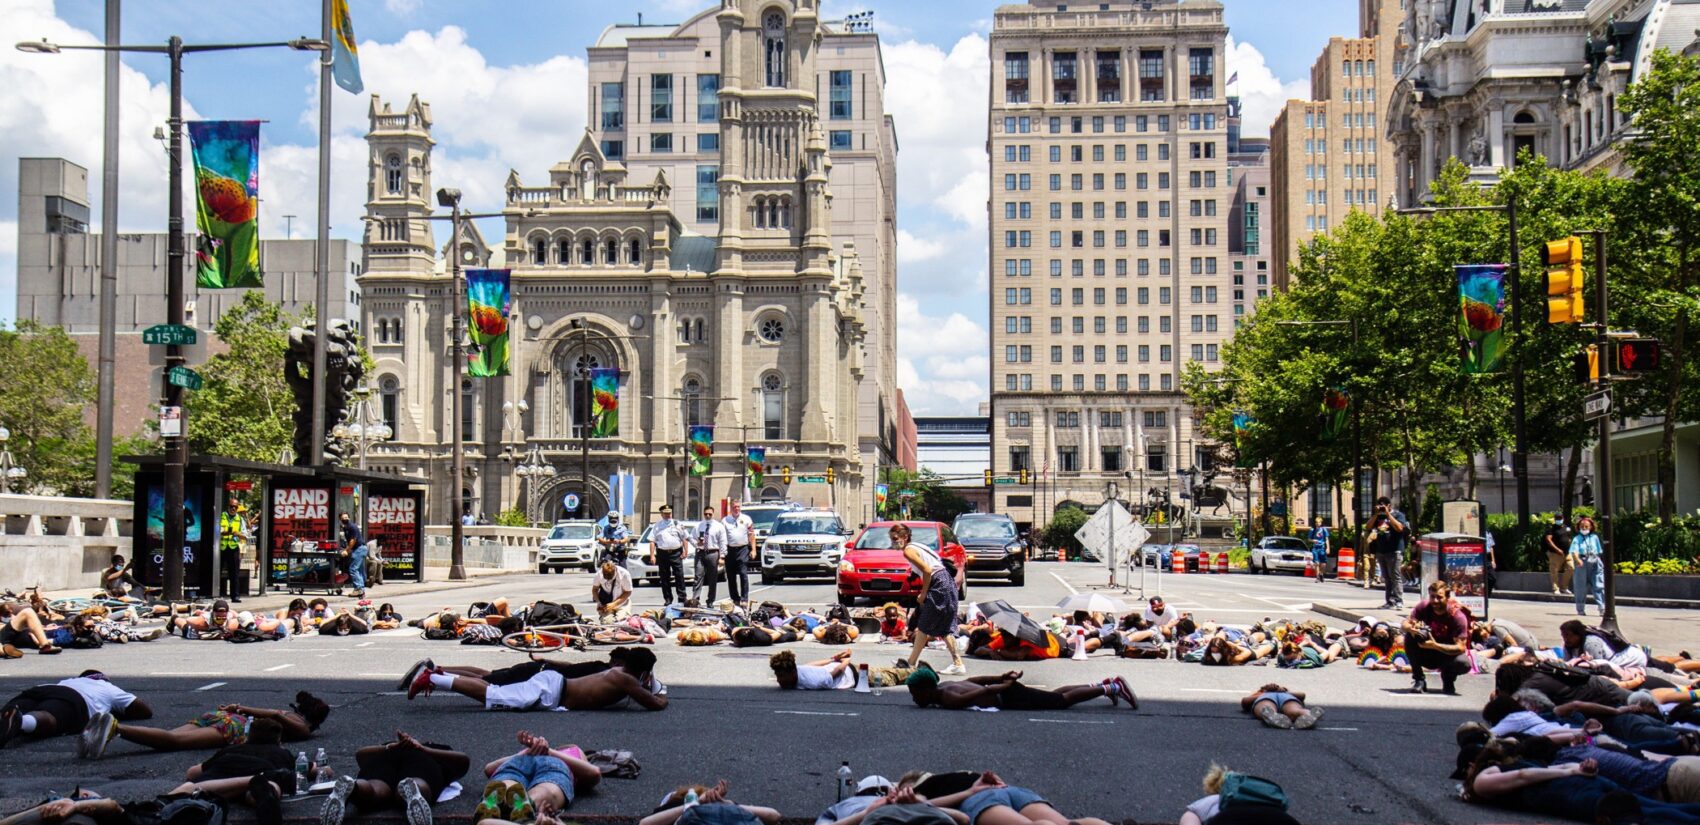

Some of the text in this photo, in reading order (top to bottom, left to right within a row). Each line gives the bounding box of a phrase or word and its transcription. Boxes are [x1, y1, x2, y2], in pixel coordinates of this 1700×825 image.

[274, 489, 328, 504] RAND
[368, 498, 416, 511] RAND
[274, 505, 328, 519] SPEAR
[368, 512, 415, 523] SPEAR
[290, 520, 313, 529] THE
[383, 524, 402, 532] THE
